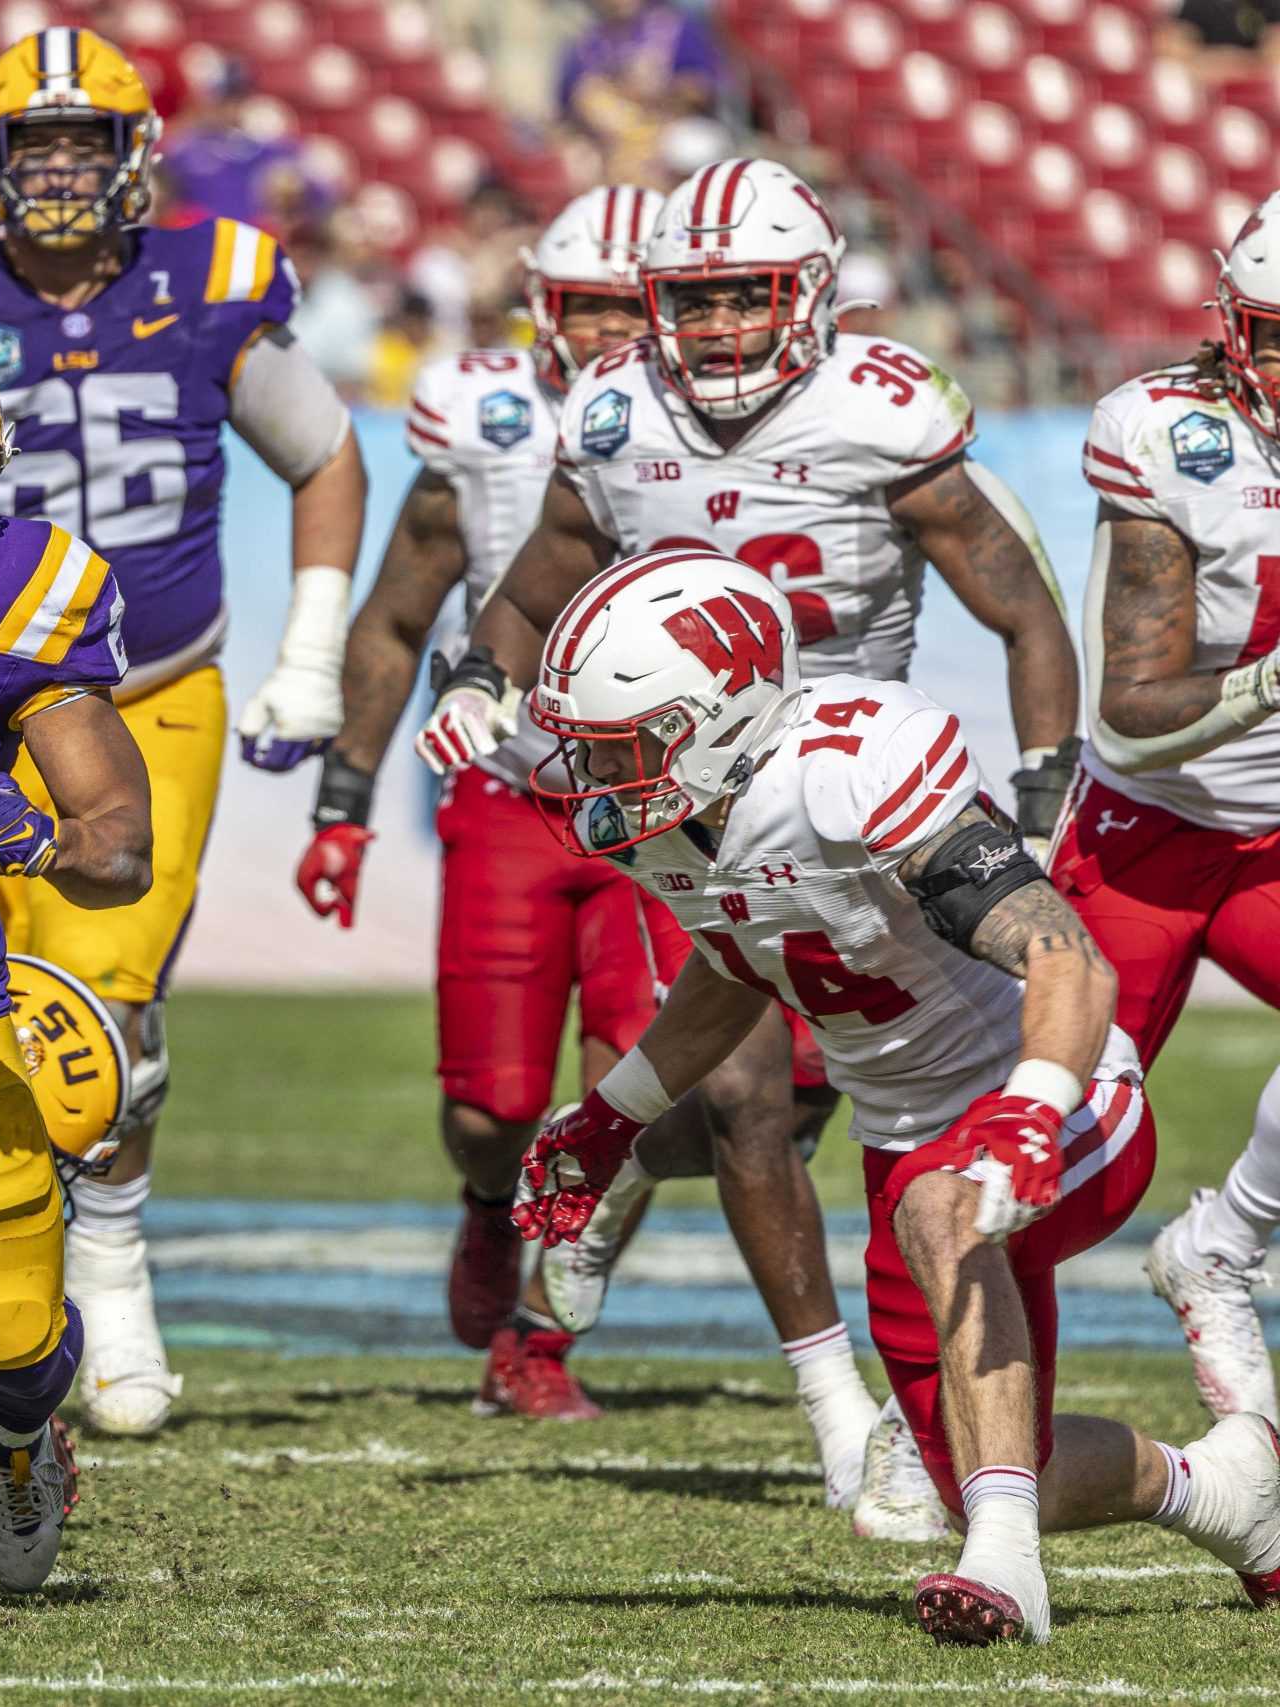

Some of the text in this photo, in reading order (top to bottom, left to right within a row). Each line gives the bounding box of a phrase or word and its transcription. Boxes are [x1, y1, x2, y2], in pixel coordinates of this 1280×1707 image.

[149, 270, 174, 304] 7
[849, 345, 932, 407] 36
[661, 590, 785, 698] W
[798, 697, 883, 758] 14
[697, 929, 919, 1030] 14
[10, 1000, 100, 1086] SU
